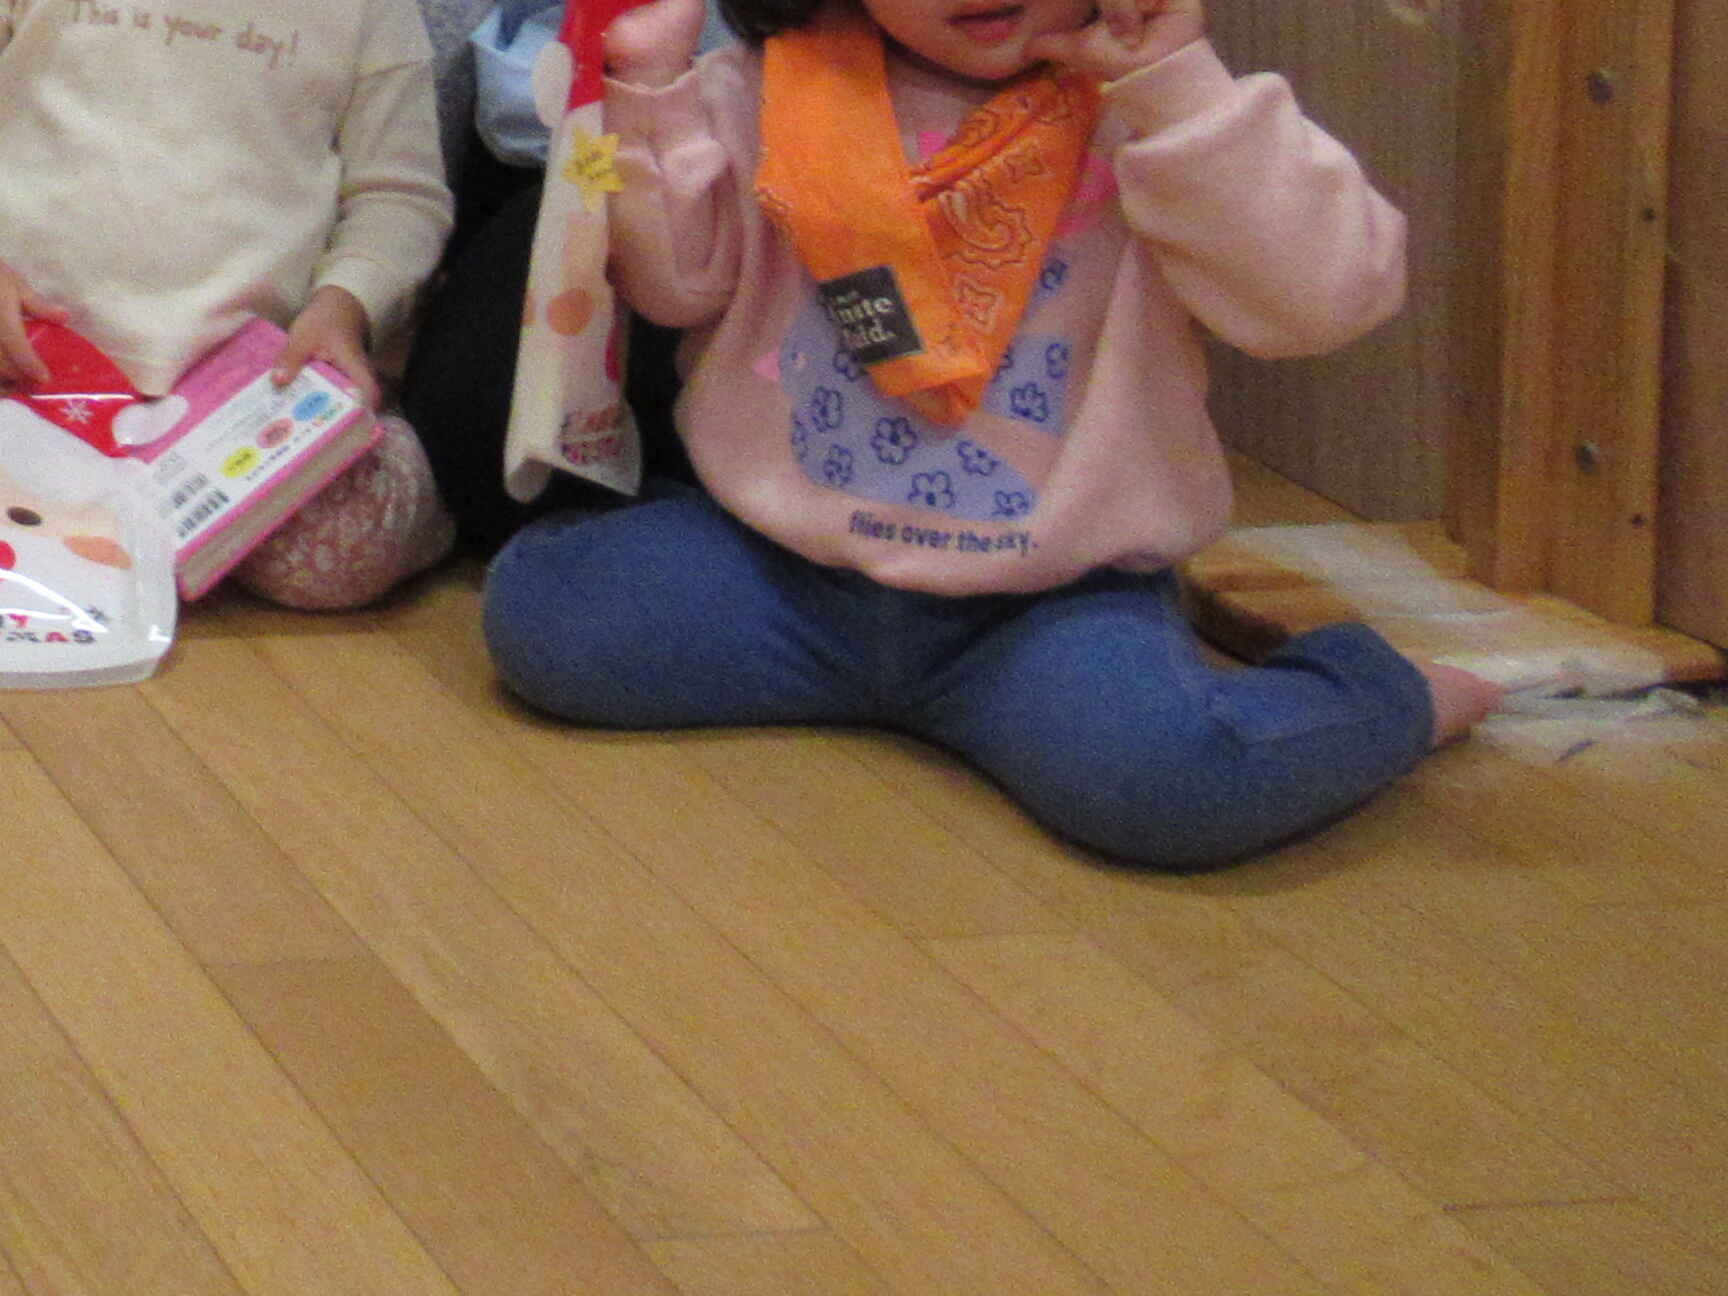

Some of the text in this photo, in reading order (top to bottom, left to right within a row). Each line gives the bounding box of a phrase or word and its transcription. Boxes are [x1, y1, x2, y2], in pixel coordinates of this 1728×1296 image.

[163, 14, 225, 46] your
[900, 525, 952, 548] over
[956, 529, 991, 553] the
